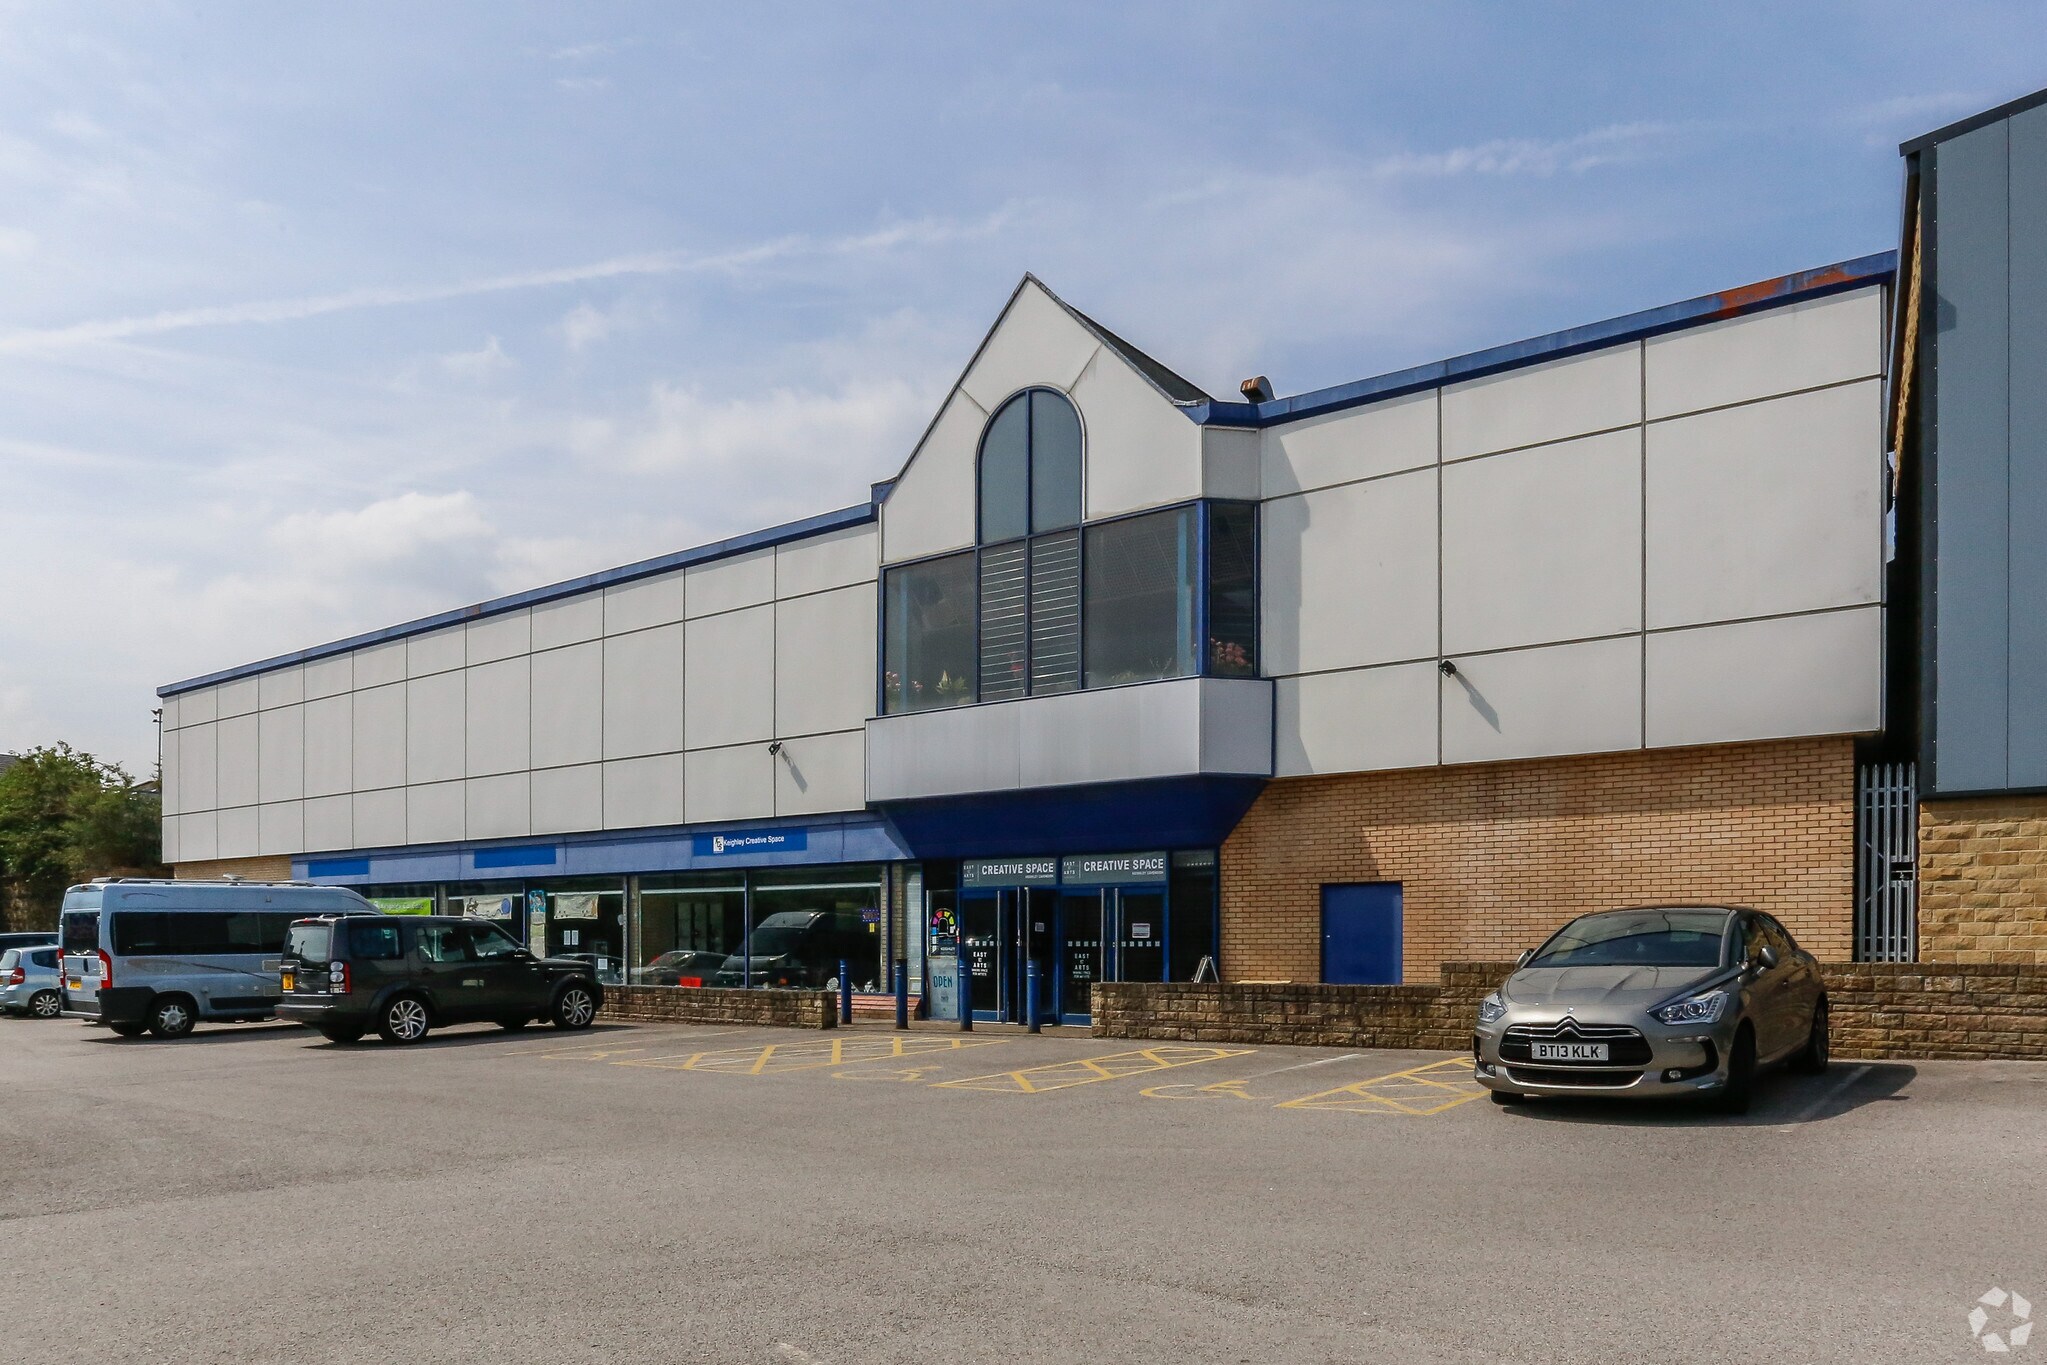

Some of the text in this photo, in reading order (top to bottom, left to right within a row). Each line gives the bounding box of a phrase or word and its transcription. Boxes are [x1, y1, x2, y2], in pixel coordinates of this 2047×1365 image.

[724, 835, 784, 848] Keighley Creative Space
[981, 862, 1054, 875] CREATIVE SPACE
[1083, 858, 1164, 872] CREATIVE SPACE
[933, 975, 953, 988] OPEN
[1539, 1045, 1599, 1058] BT13 KLK
